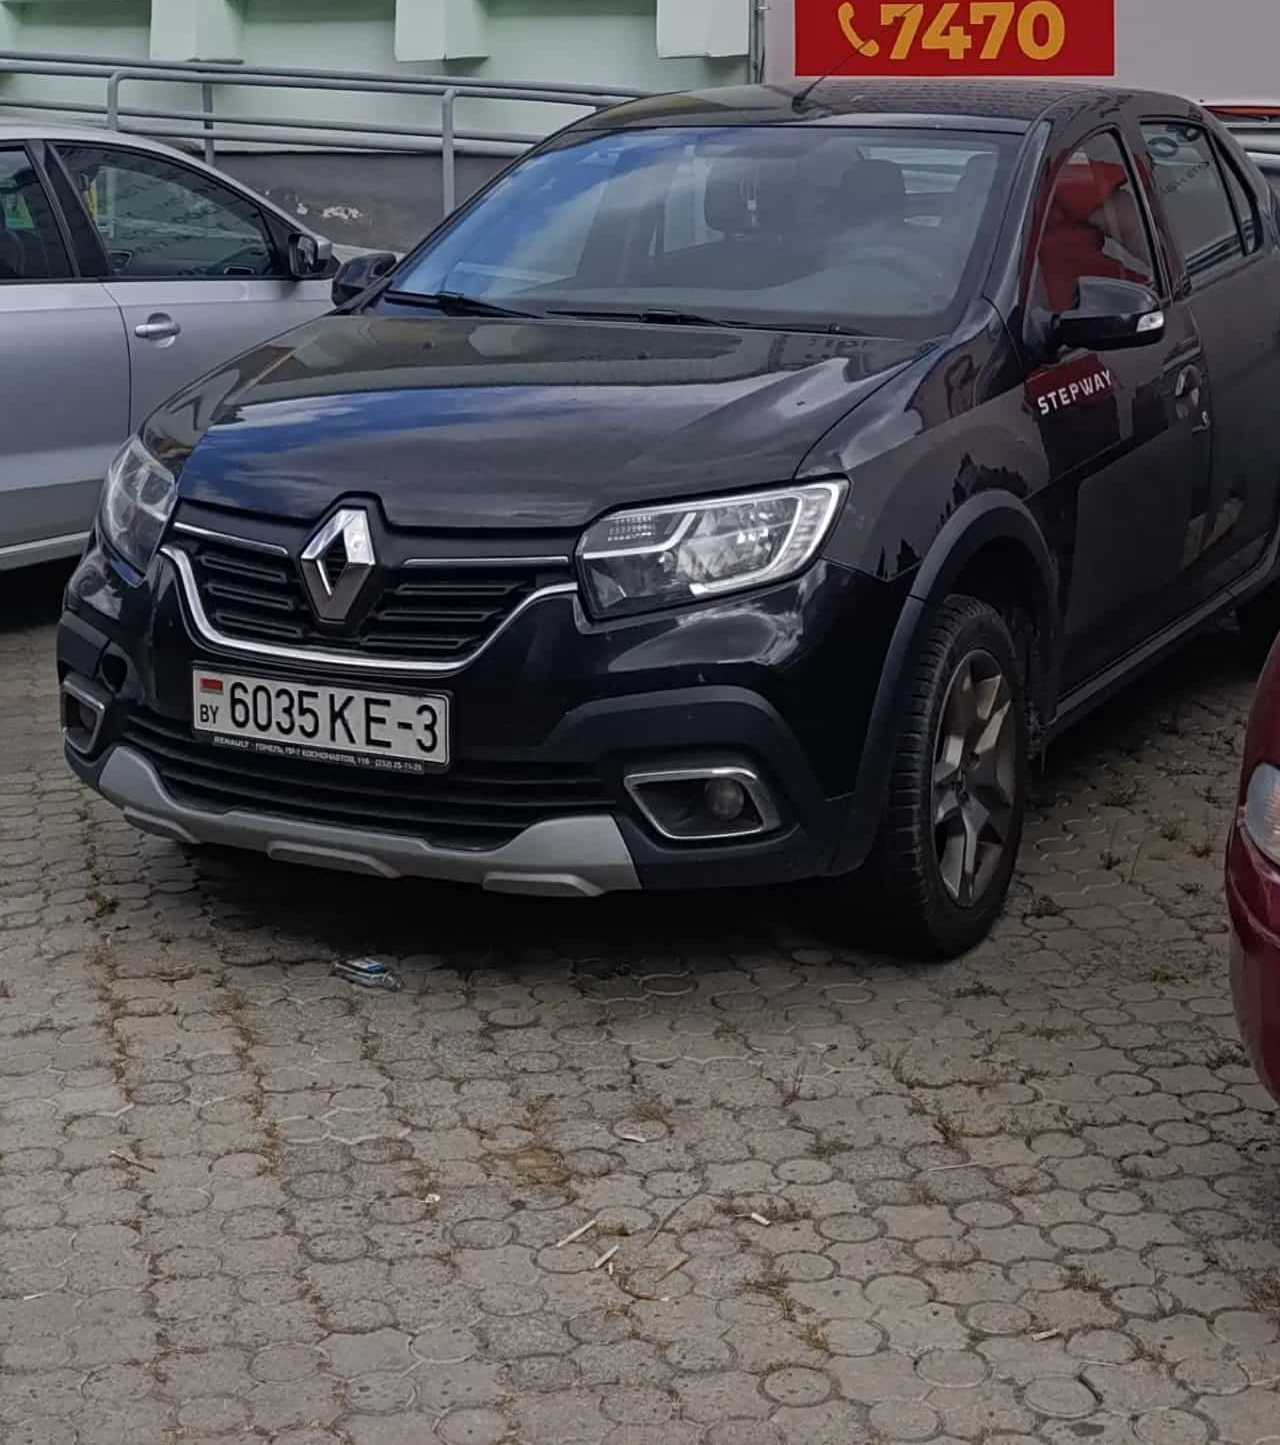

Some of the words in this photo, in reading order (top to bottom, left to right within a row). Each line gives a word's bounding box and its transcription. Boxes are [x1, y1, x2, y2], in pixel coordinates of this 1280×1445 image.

[880, 0, 1066, 61] 7470
[1037, 369, 1112, 415] STEPWAY
[200, 704, 219, 724] BY
[230, 682, 320, 738] 6035
[329, 693, 438, 753] KE-3
